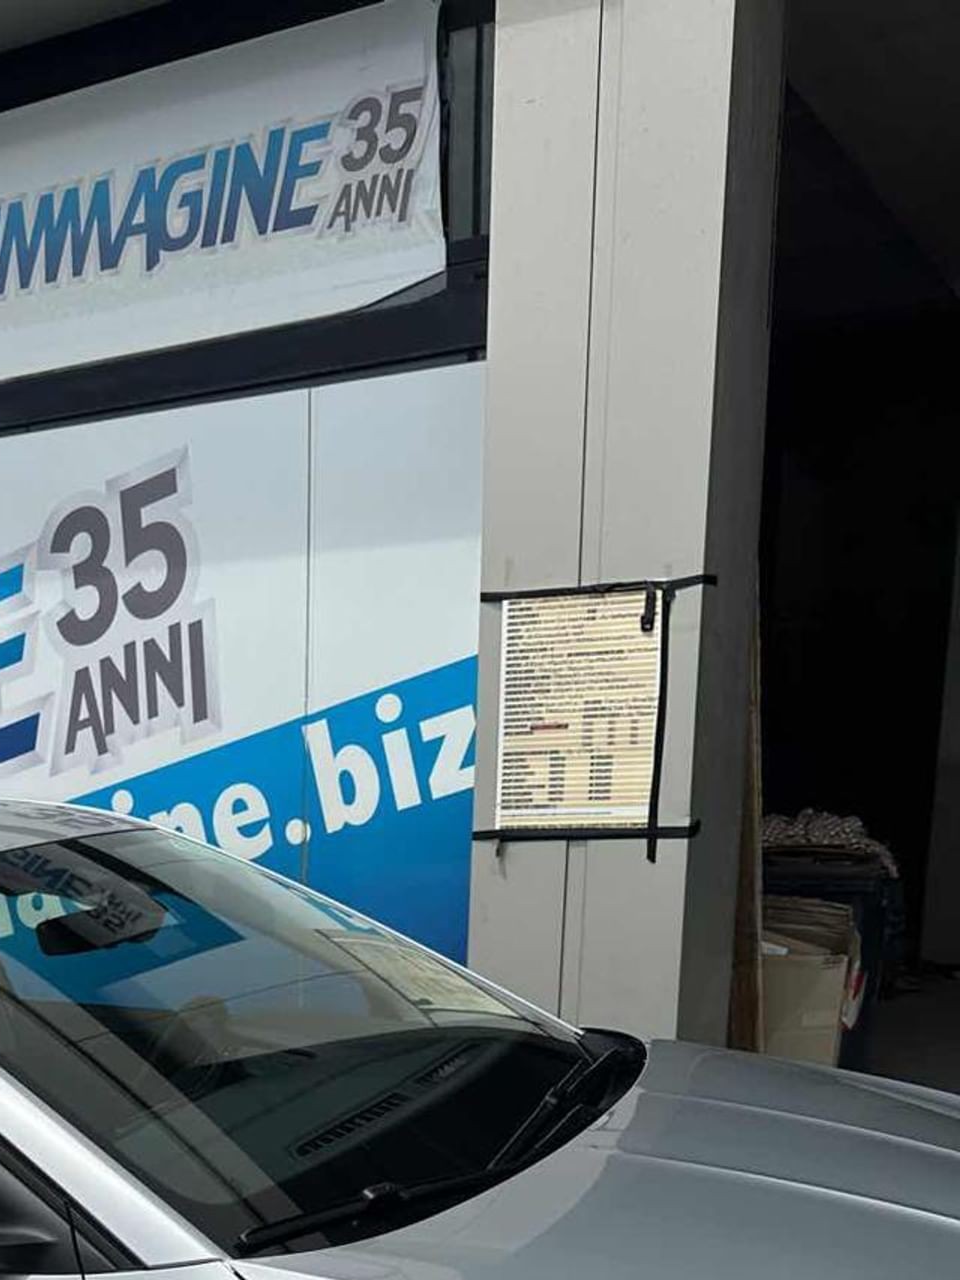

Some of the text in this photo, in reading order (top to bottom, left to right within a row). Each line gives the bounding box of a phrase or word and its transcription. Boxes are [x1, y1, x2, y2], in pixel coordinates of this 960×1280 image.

[340, 85, 423, 172] 35
[328, 168, 415, 233] ANNI
[50, 467, 187, 647] 35
[64, 619, 208, 756] ANNI
